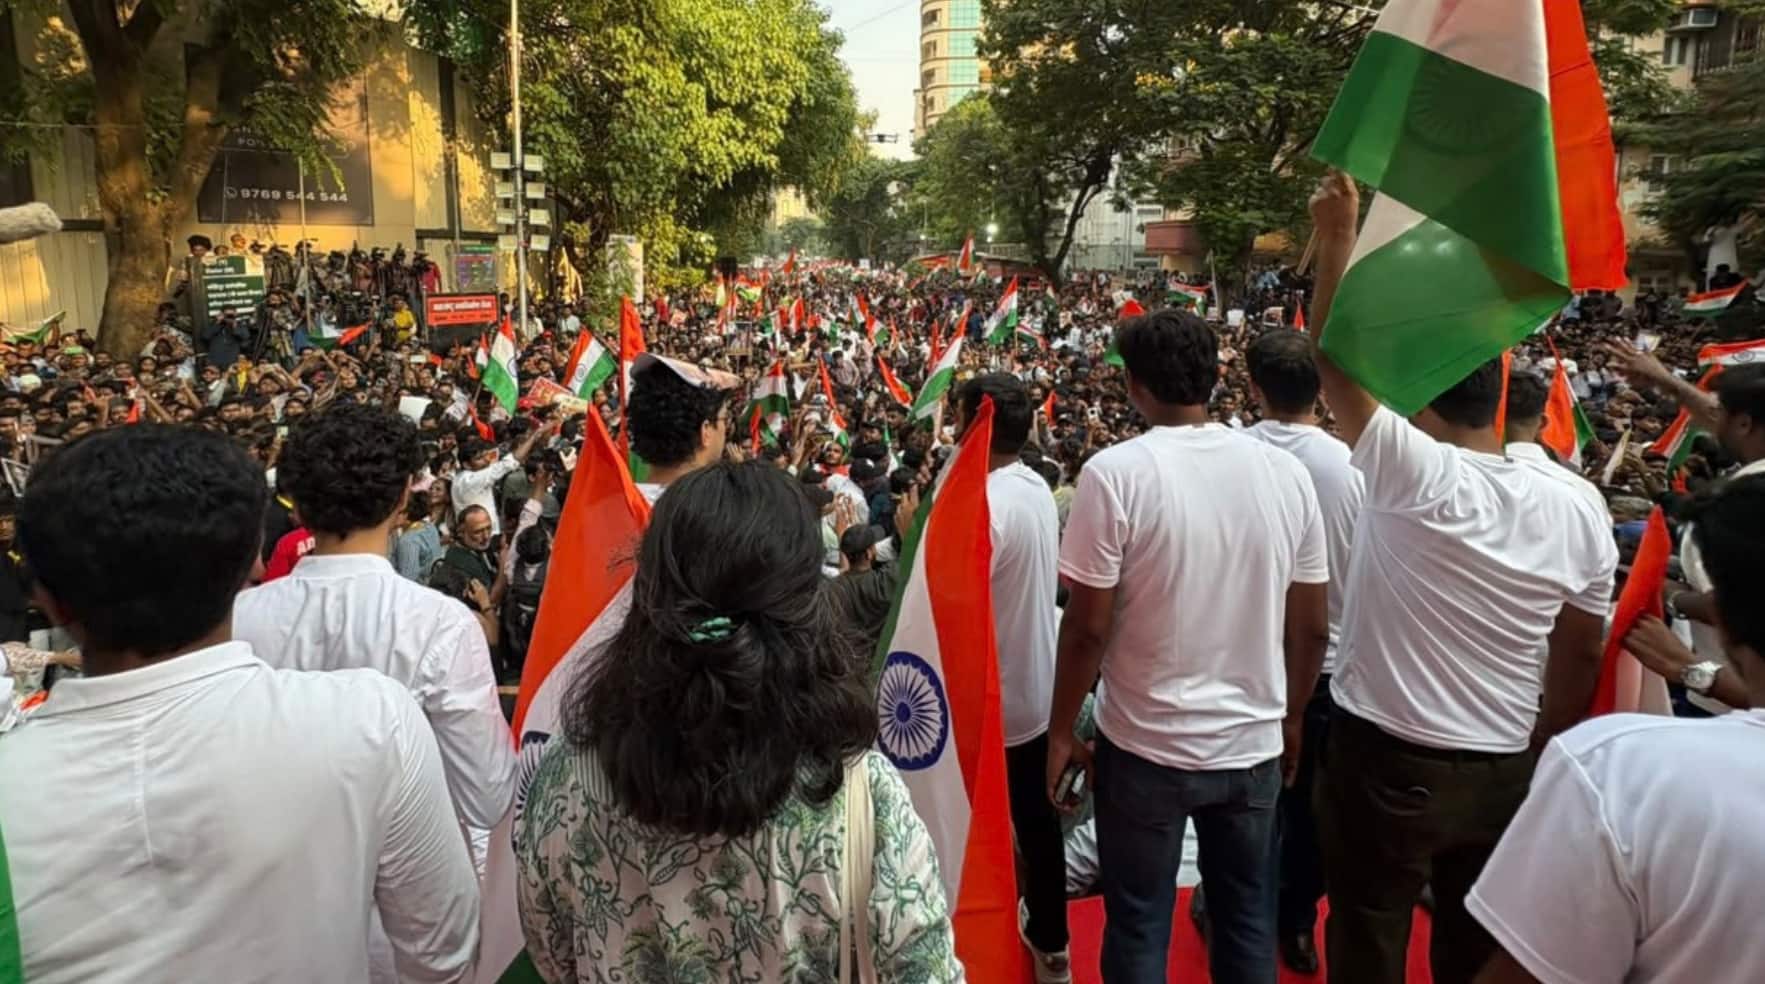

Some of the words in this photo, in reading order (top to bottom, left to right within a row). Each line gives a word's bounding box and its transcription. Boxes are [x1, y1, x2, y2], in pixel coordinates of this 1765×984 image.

[240, 187, 281, 200] 9769
[285, 190, 315, 201] 544
[319, 191, 348, 202] 544
